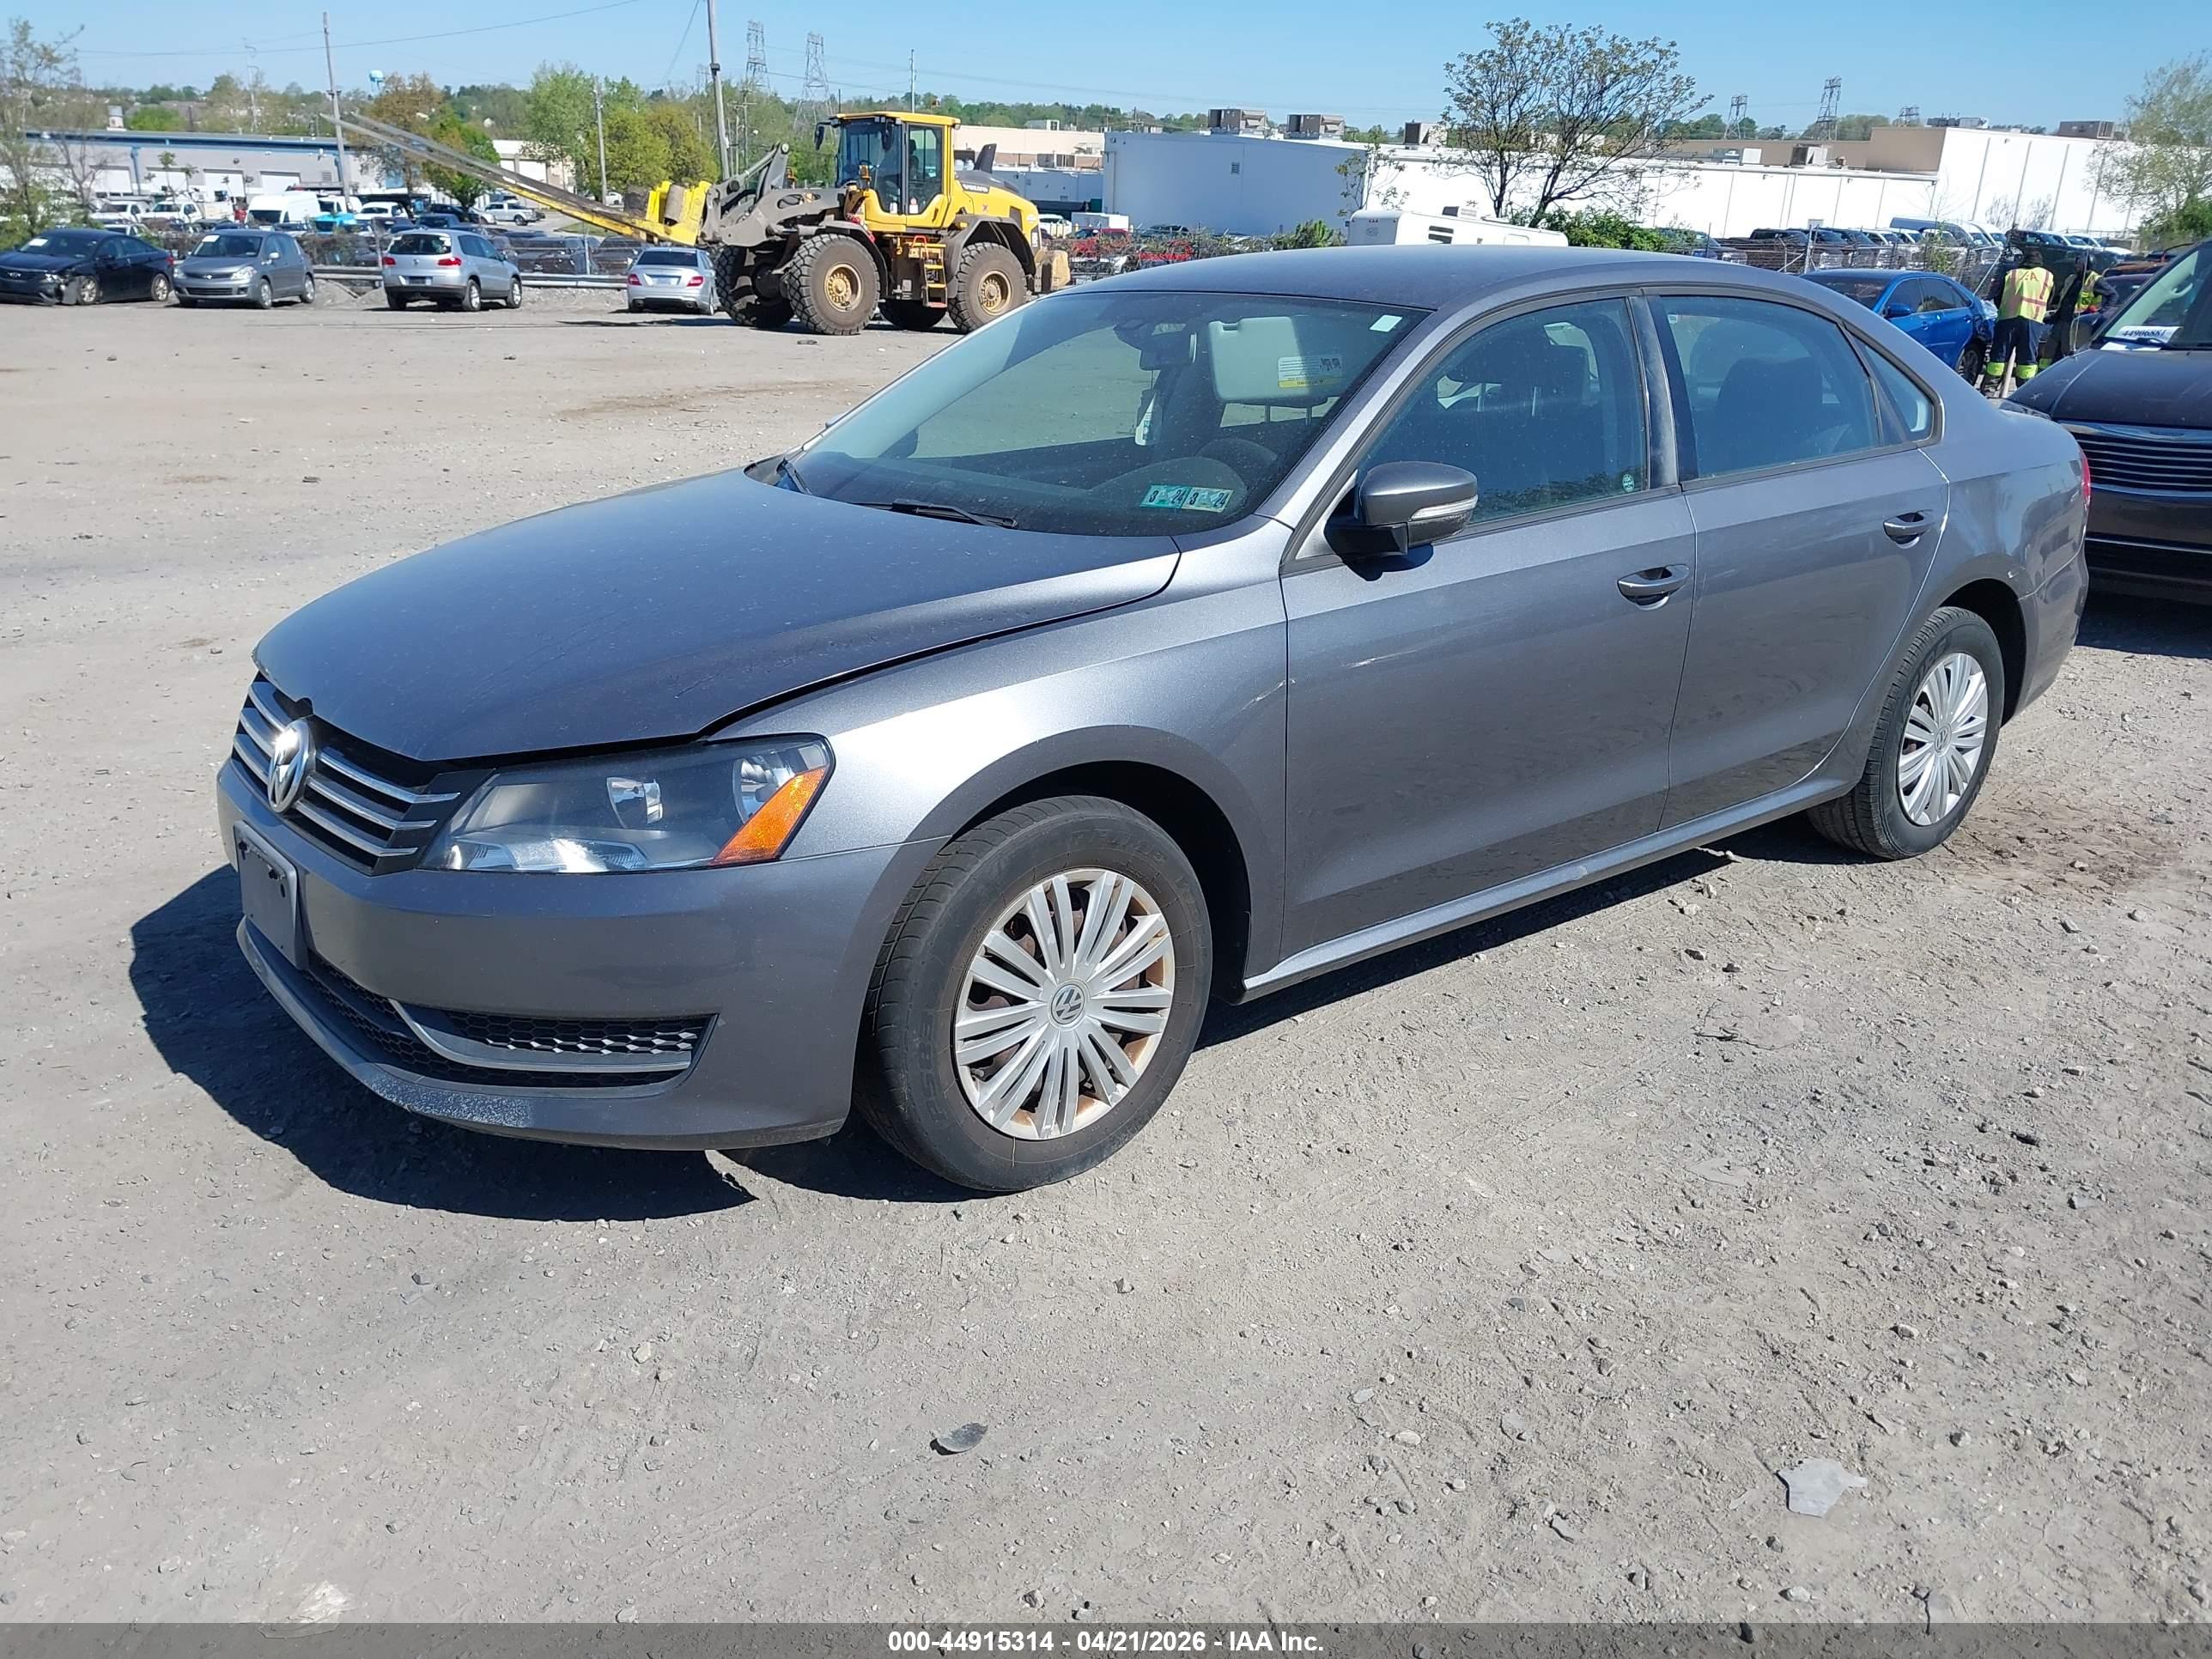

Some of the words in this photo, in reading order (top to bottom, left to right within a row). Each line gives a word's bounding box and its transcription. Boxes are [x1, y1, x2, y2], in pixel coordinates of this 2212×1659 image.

[1149, 490, 1159, 503] 3
[1171, 489, 1187, 504] 24
[1189, 492, 1199, 505] 3
[1213, 493, 1229, 507] 24
